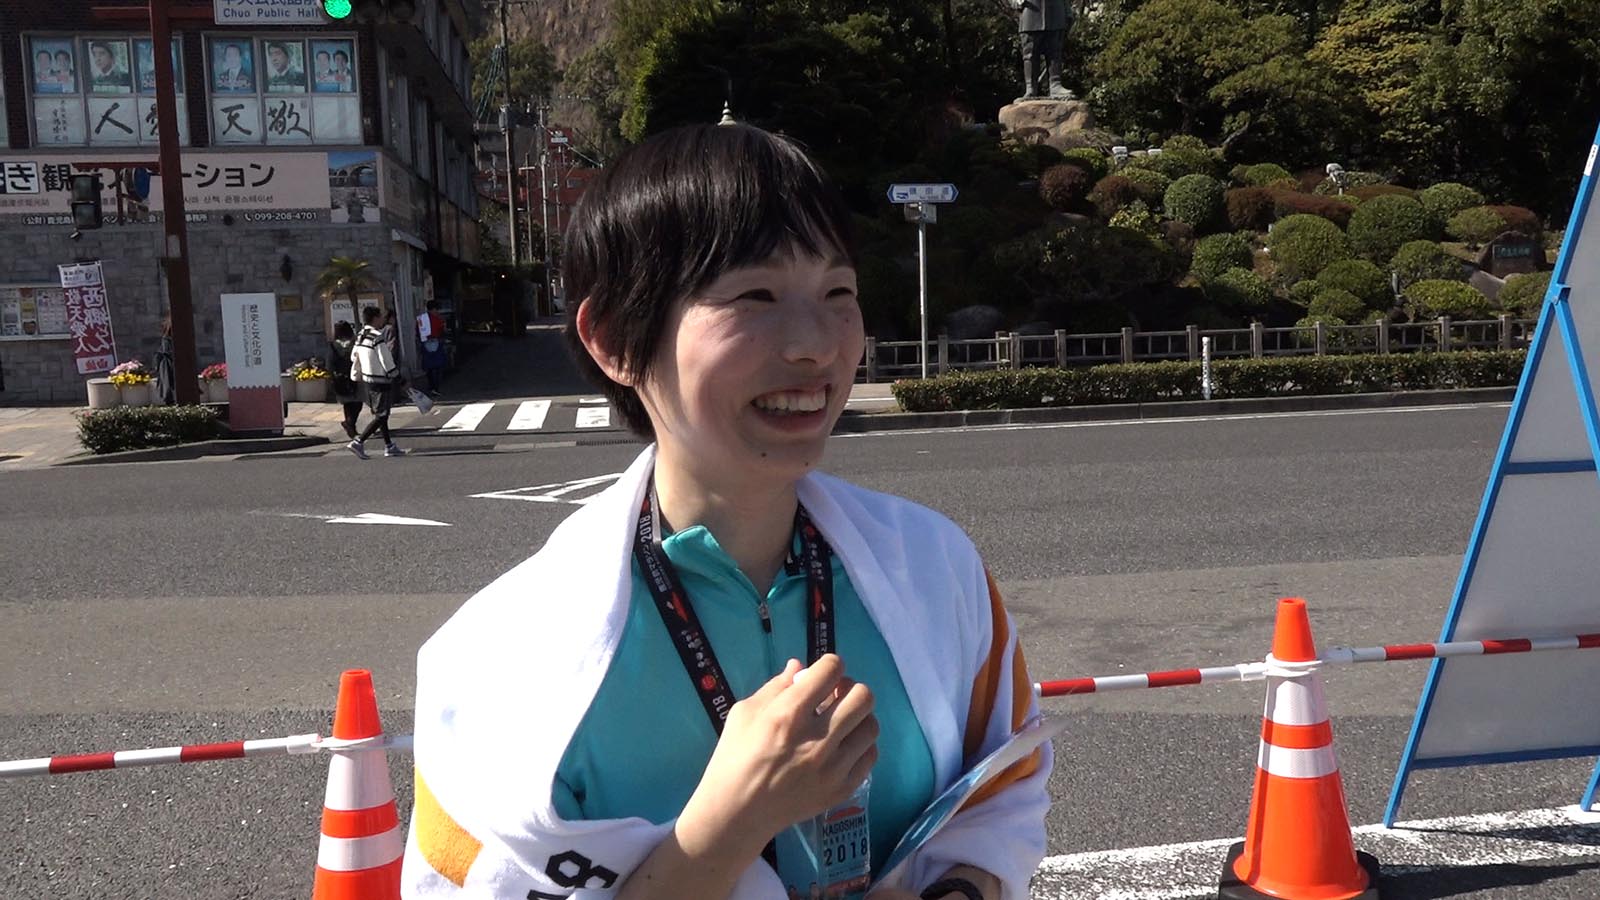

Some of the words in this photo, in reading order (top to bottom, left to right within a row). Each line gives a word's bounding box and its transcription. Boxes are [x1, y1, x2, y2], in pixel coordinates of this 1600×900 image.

[223, 8, 250, 18] Chuo
[257, 8, 290, 18] Public
[639, 514, 652, 543] 2018
[824, 838, 867, 866] 2018
